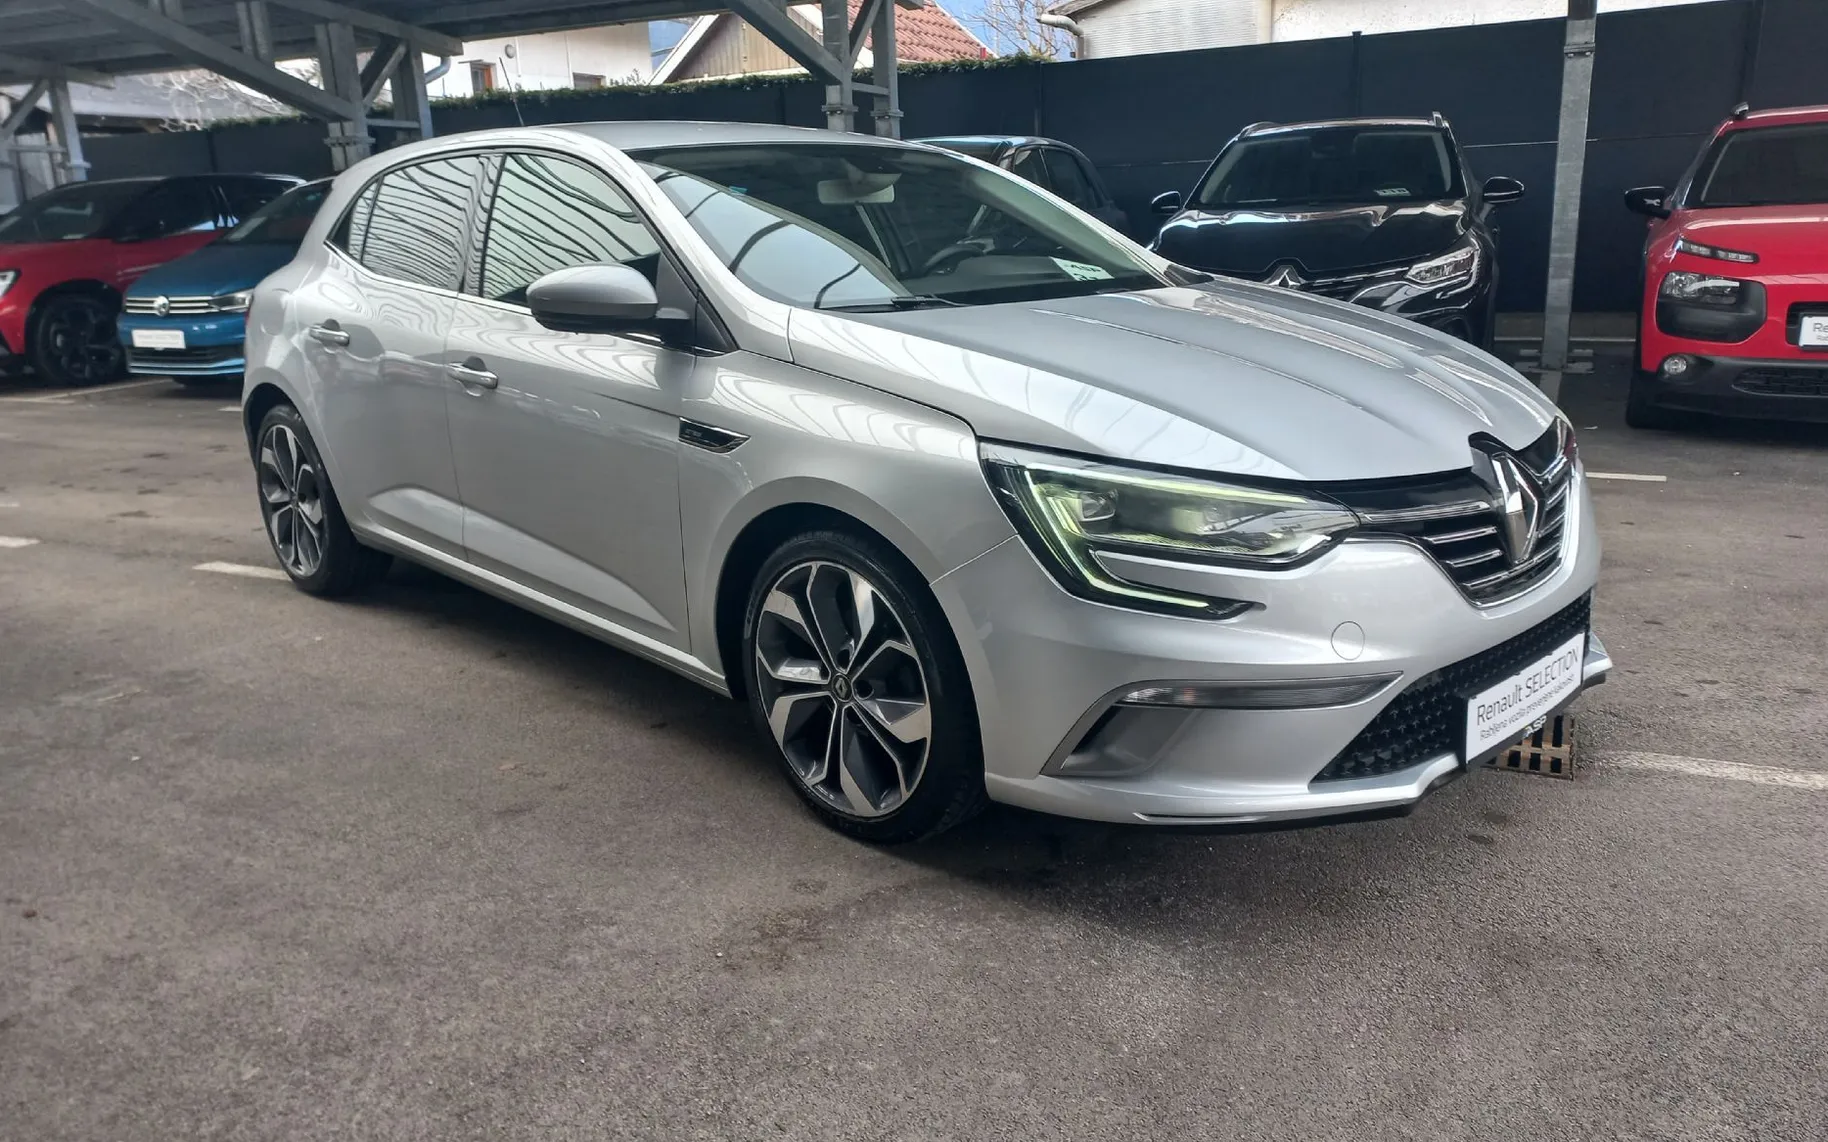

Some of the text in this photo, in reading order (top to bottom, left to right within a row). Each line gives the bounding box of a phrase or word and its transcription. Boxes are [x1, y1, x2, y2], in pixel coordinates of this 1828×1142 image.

[1477, 647, 1579, 726] Renault SELECTION
[1524, 714, 1547, 738] ASP
